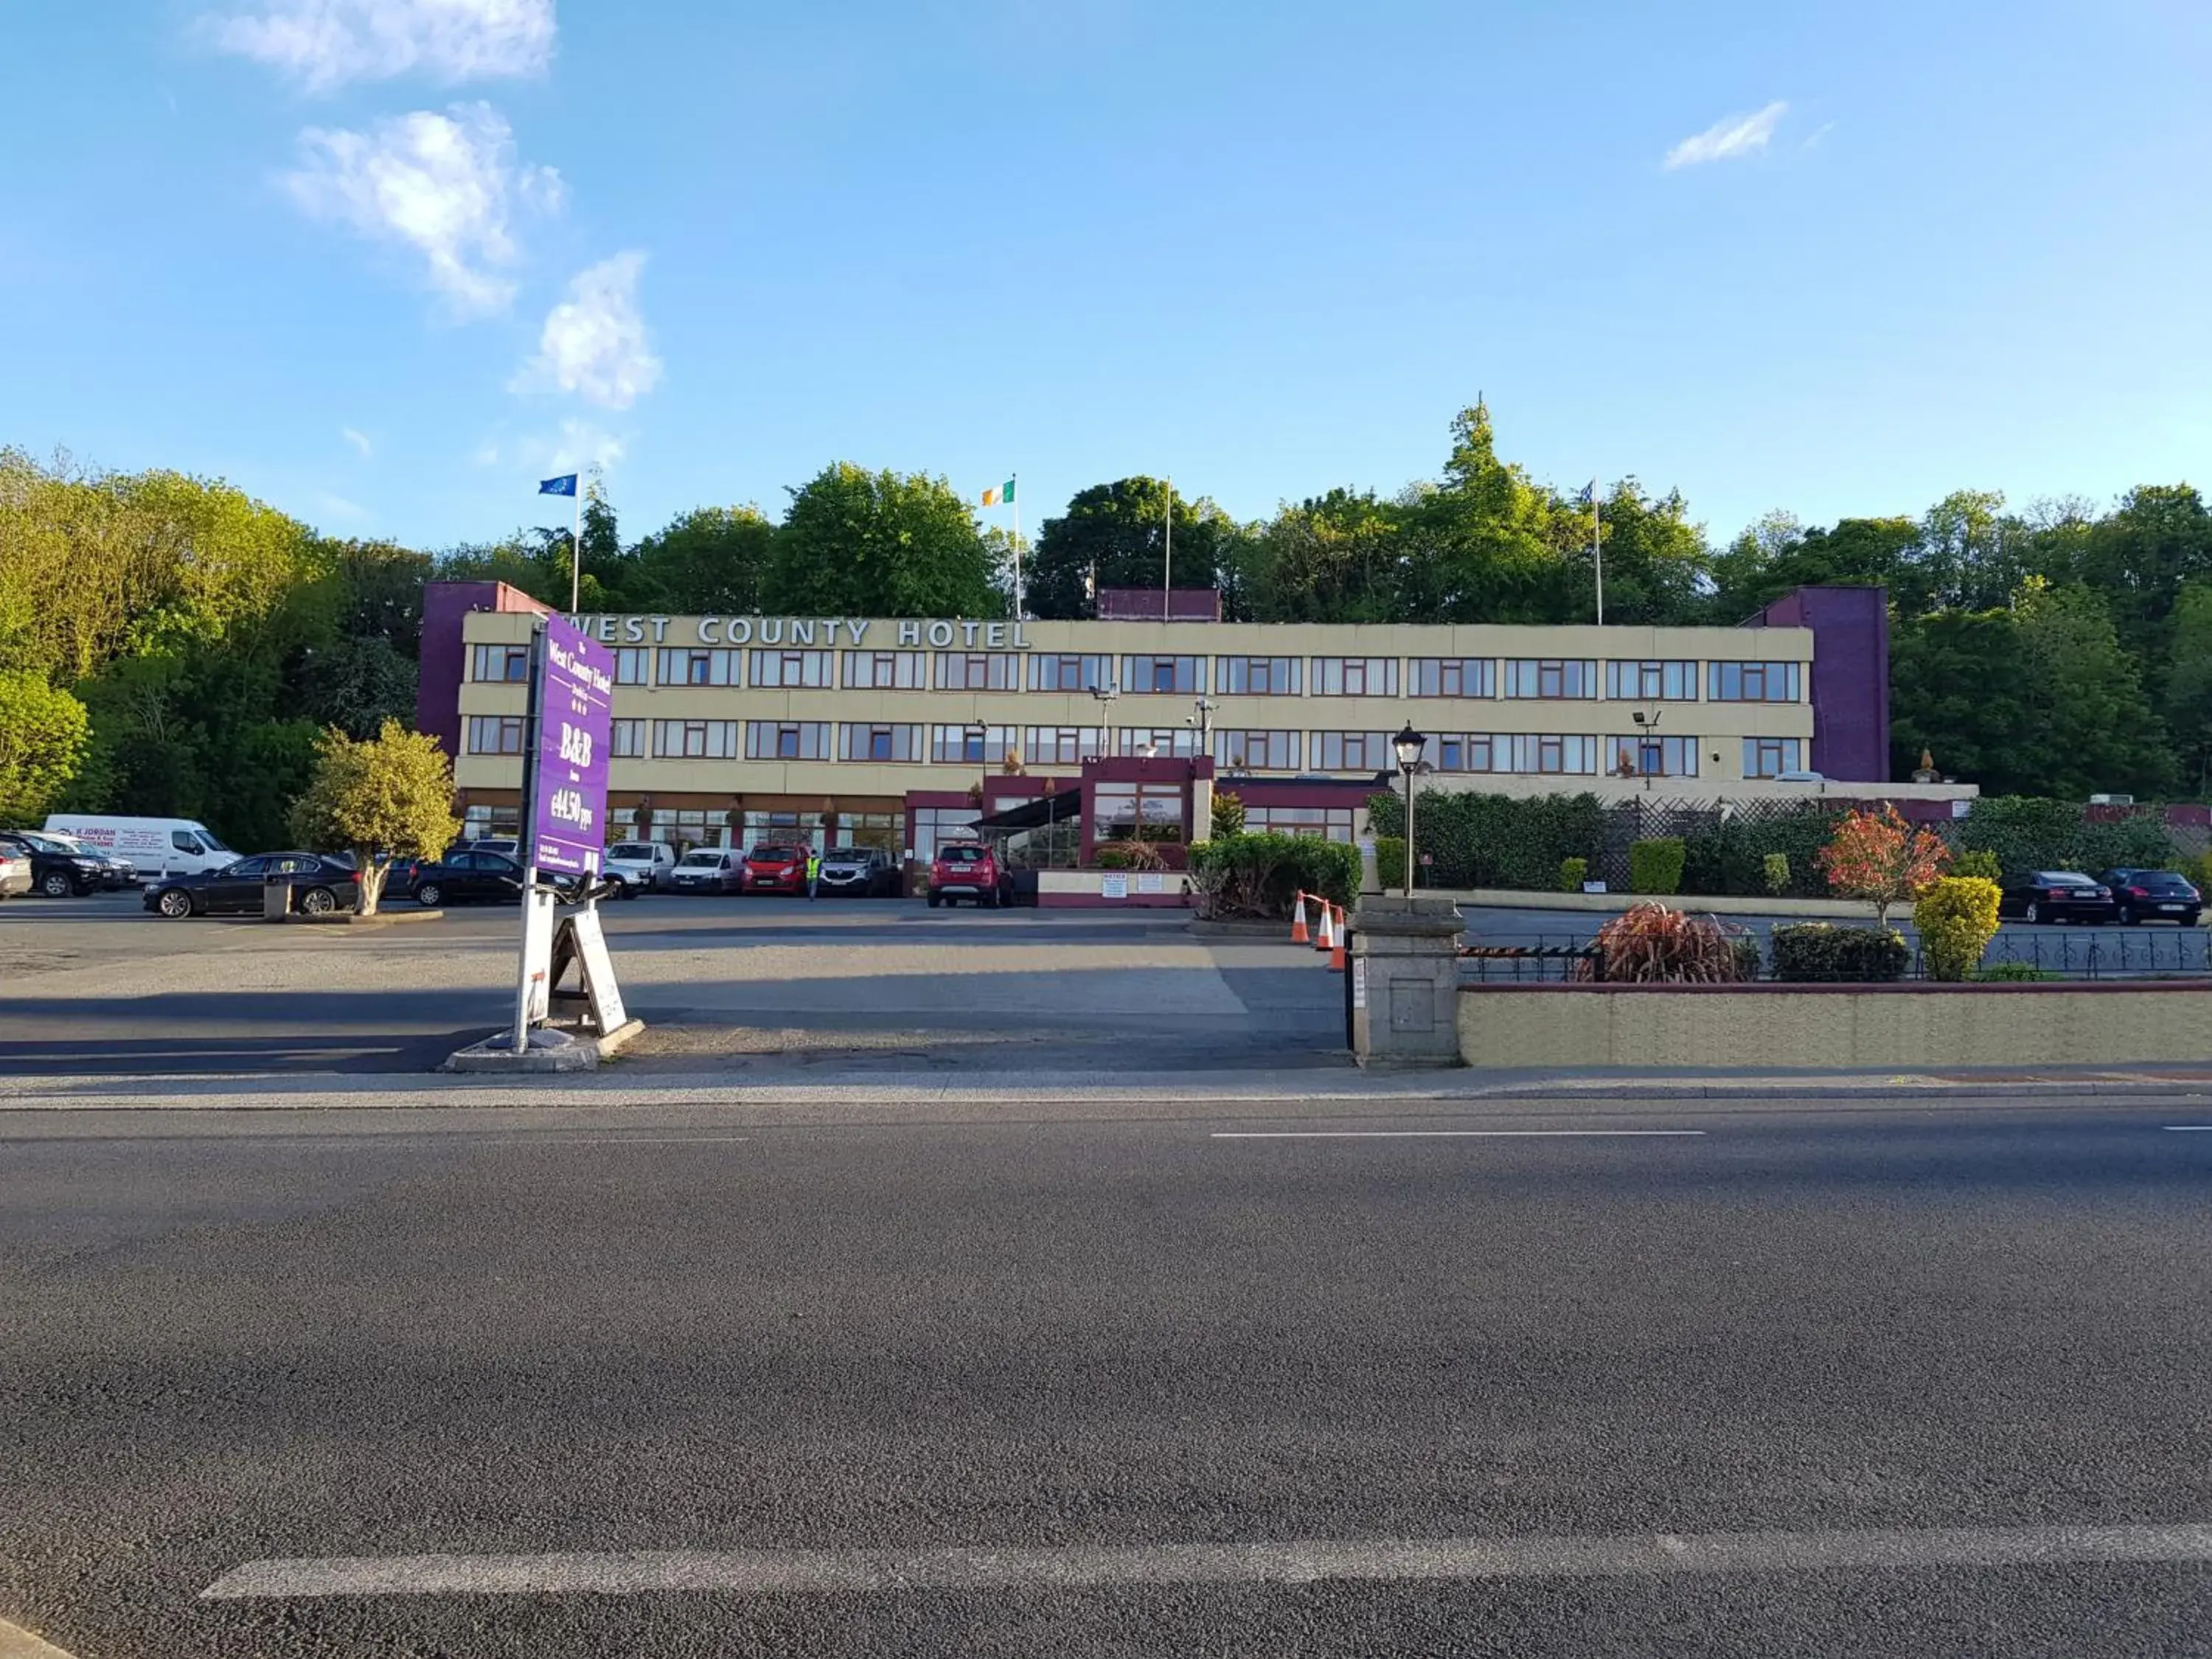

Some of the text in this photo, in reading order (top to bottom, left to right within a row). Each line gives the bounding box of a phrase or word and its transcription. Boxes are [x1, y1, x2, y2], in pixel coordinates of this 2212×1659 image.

[698, 617, 869, 644] COUNTY
[897, 620, 1031, 648] HOTEL
[549, 639, 611, 695] West County Hotel
[560, 722, 592, 768] B&B
[83, 828, 116, 836] JORDAN
